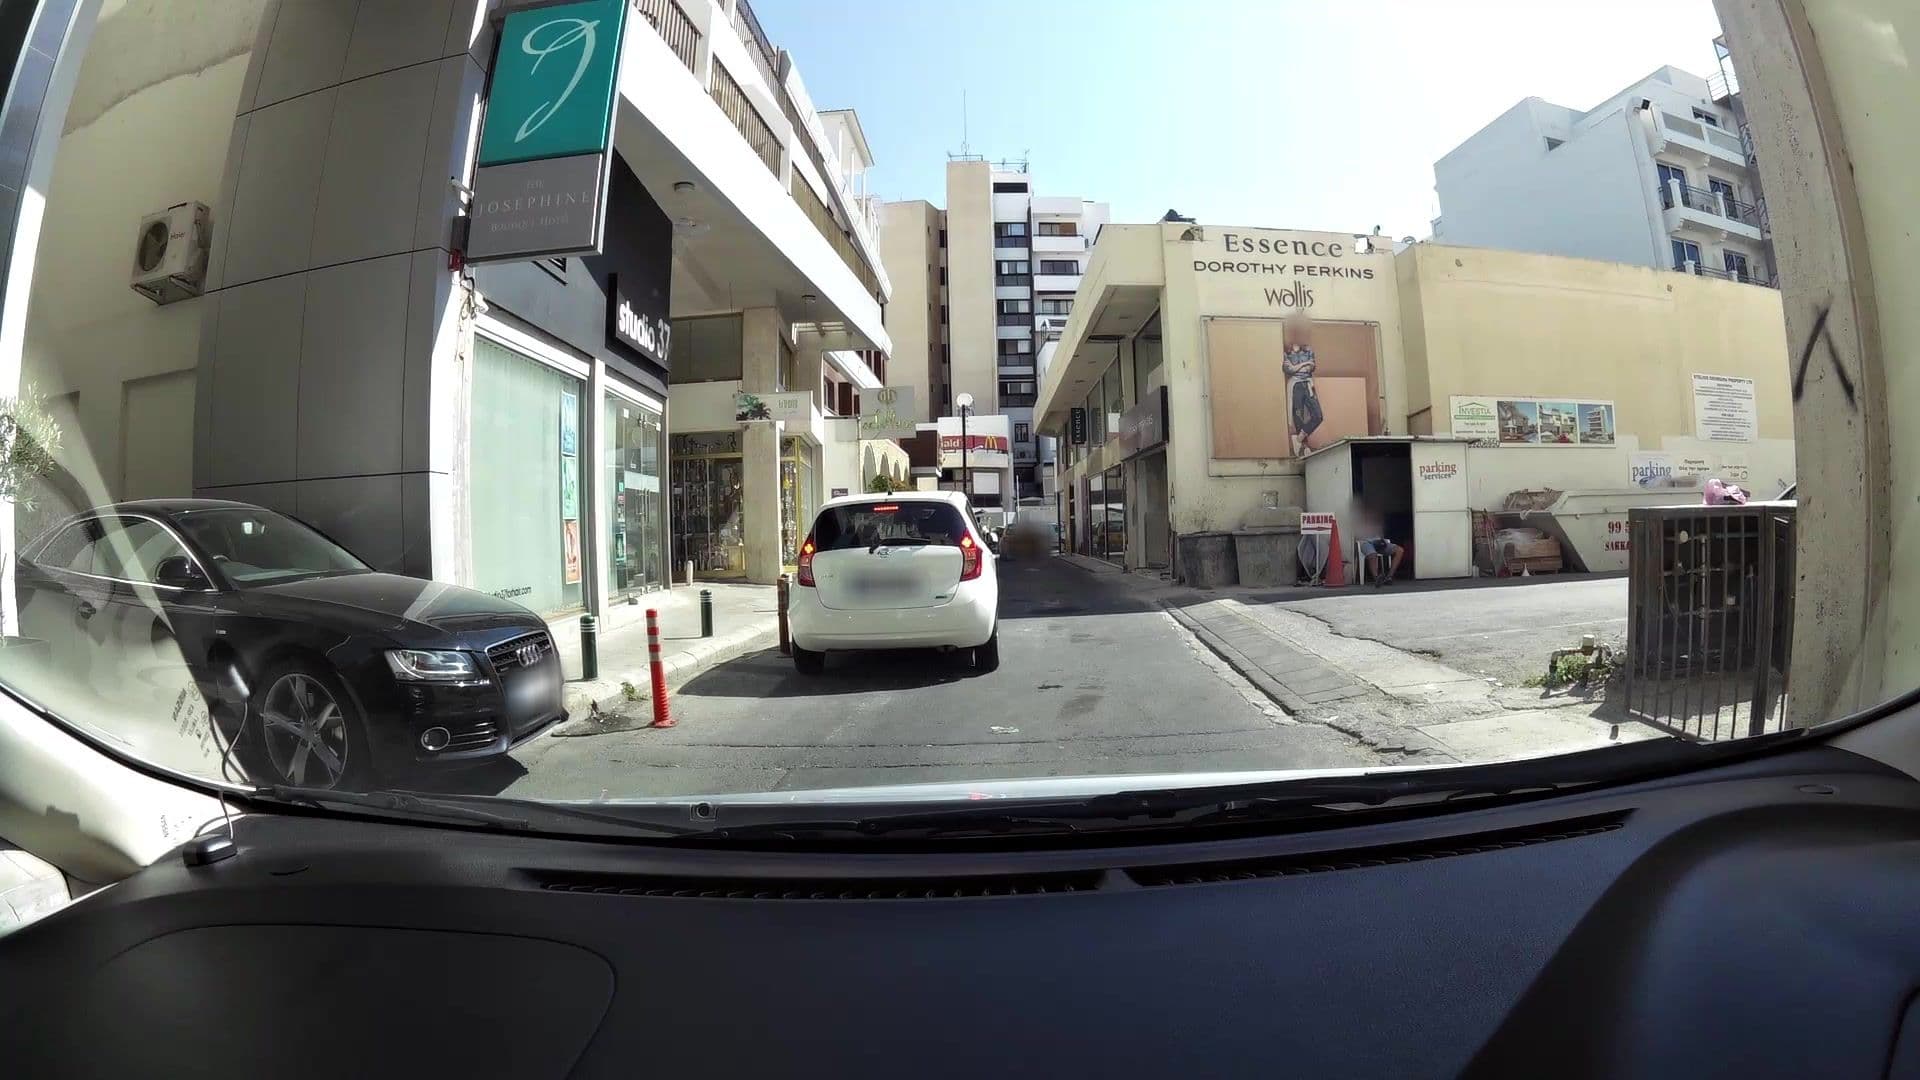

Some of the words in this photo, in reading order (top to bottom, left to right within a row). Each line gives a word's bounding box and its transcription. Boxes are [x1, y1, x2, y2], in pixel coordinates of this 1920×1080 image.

[478, 191, 591, 217] JOSEPHINE
[1224, 234, 1343, 258] Essence
[1193, 260, 1287, 275] DOROTHY
[1294, 265, 1375, 280] PERKINS
[618, 300, 656, 353] studio
[657, 318, 671, 361] 37
[1419, 461, 1457, 477] parking
[1424, 472, 1453, 481] services
[1632, 460, 1672, 481] parking
[1302, 515, 1334, 524] PARKING
[1607, 520, 1622, 534] 99
